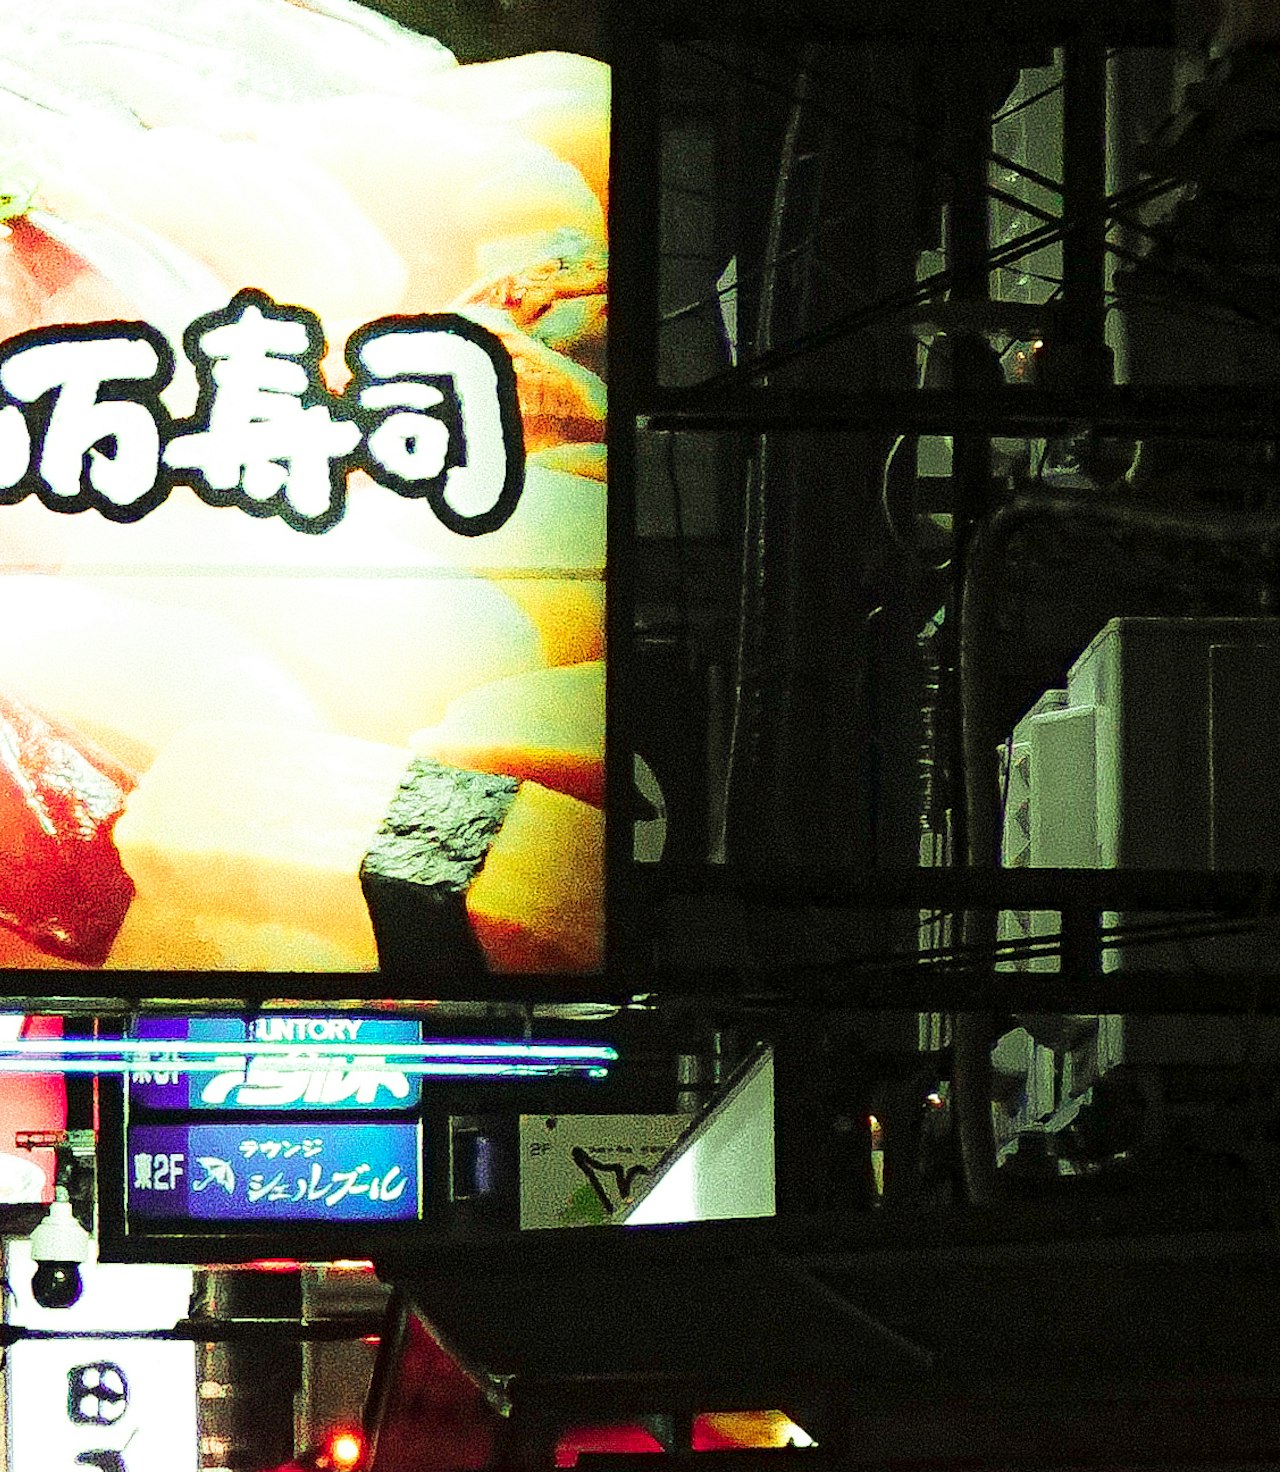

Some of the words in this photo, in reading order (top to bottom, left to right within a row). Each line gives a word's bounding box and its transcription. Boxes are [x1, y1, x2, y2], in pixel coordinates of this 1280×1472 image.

[238, 1138, 324, 1159] ラウンジ
[133, 1152, 185, 1191] 東2F
